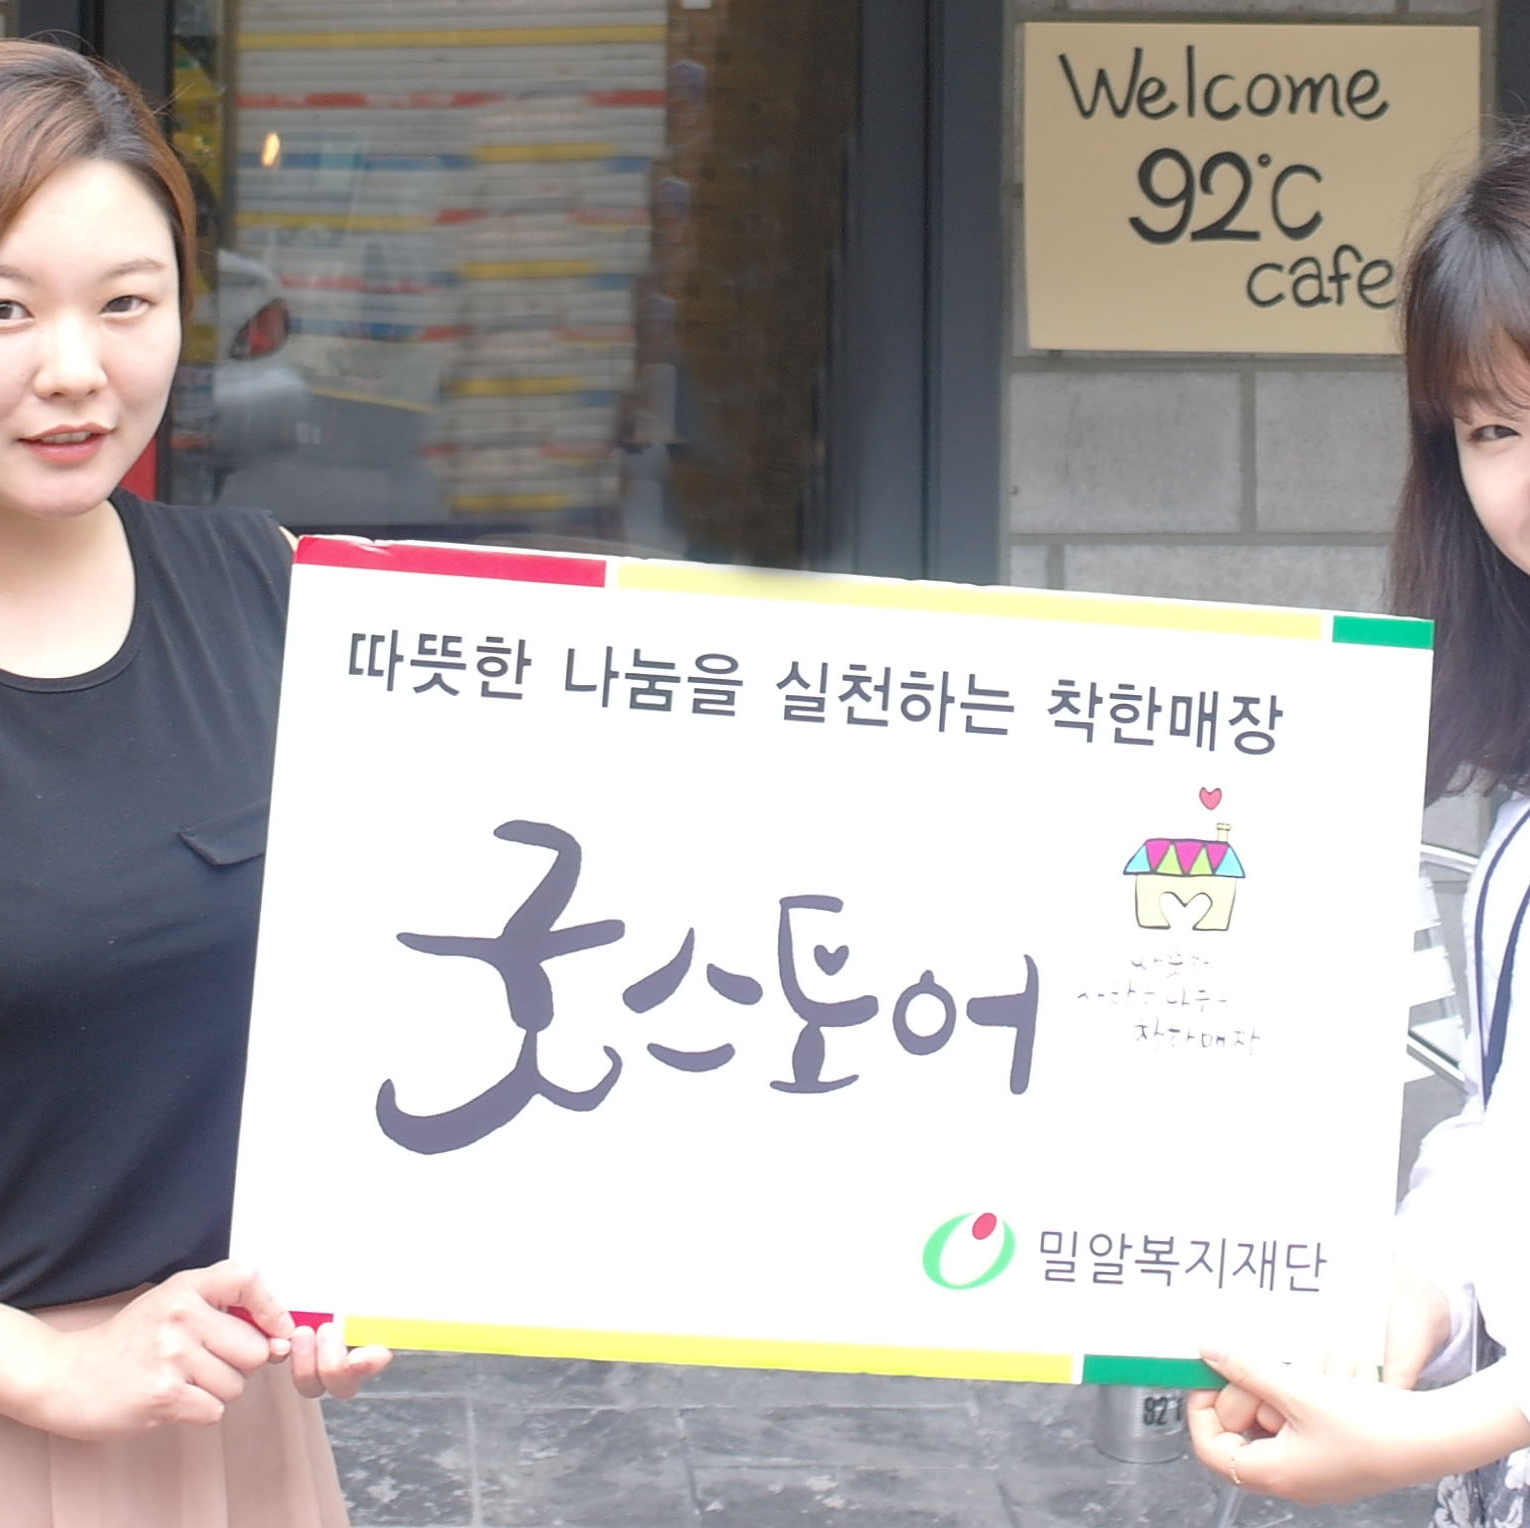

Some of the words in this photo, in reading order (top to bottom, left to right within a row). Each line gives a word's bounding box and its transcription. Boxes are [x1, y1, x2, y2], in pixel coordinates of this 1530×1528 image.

[1058, 45, 1390, 120] Welcome
[1246, 243, 1397, 310] cafe
[348, 628, 533, 701] 따뜻한
[564, 645, 744, 717] 나눔을
[775, 659, 1016, 737] 실천하는
[1047, 678, 1285, 756] 착한매장
[374, 818, 1042, 1156] 굿스토어
[1039, 1229, 1328, 1293] 밀알복지재단
